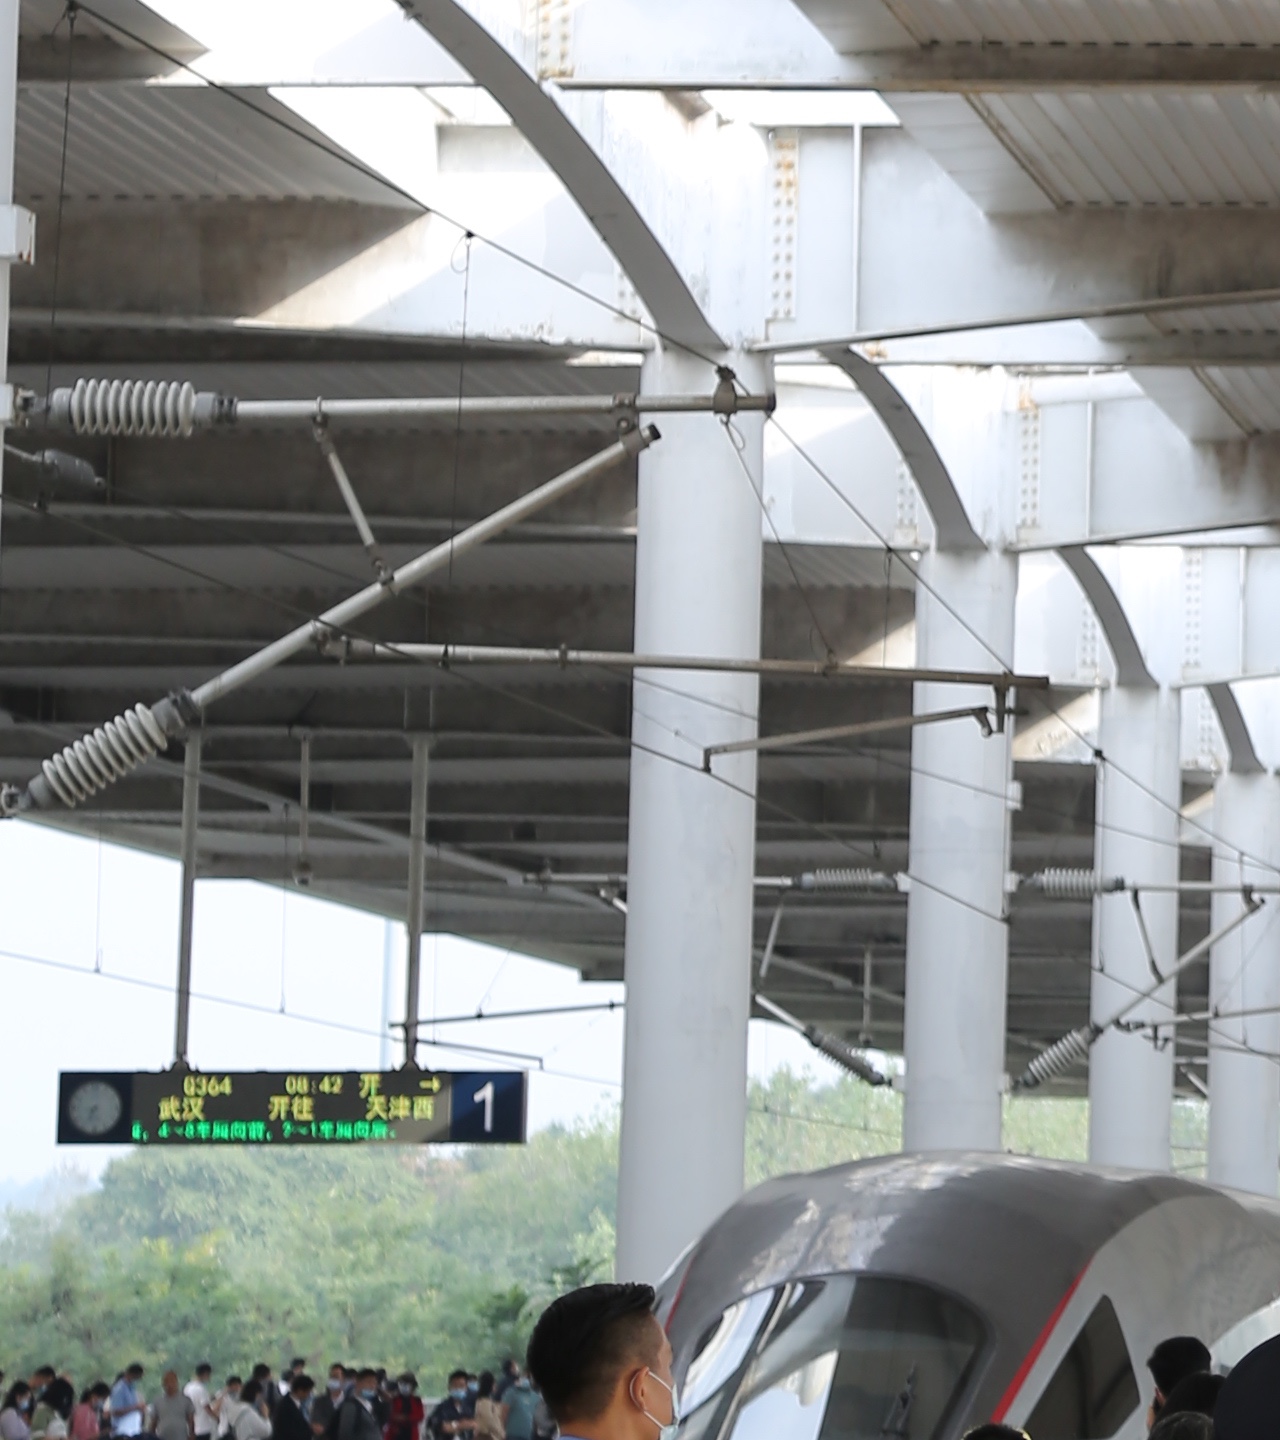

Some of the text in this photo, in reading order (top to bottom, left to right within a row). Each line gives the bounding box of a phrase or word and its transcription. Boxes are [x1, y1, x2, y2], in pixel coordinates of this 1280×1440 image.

[358, 1073, 382, 1099] 开
[158, 1095, 435, 1121] 武汉 开往 天津西
[473, 1081, 493, 1132] 1
